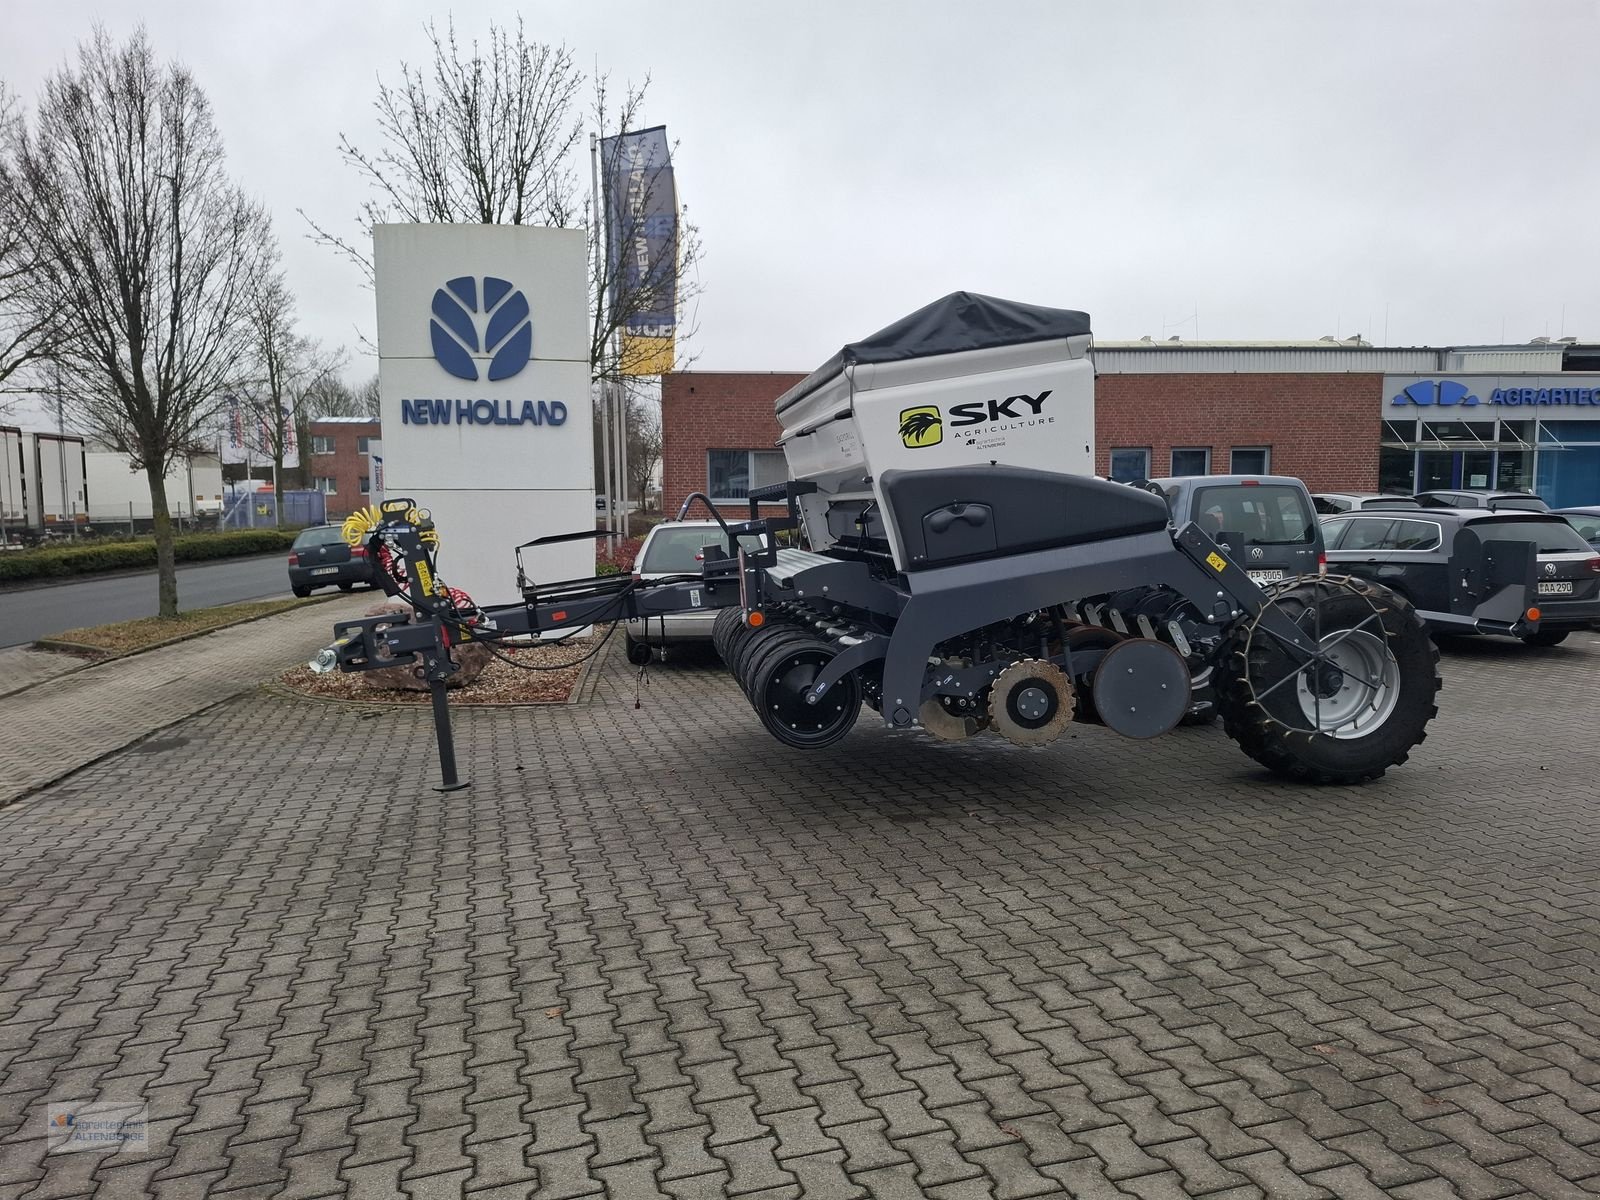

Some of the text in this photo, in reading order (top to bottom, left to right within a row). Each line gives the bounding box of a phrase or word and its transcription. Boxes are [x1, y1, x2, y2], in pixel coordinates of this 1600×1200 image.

[635, 237, 649, 280] NEW
[1490, 387, 1600, 406] AGRARTEC
[401, 398, 568, 426] NEW HOLLAND
[948, 390, 1053, 427] SKY
[954, 416, 1056, 439] AGRICULTURE
[1262, 571, 1281, 579] 3005
[1556, 582, 1572, 592] 290
